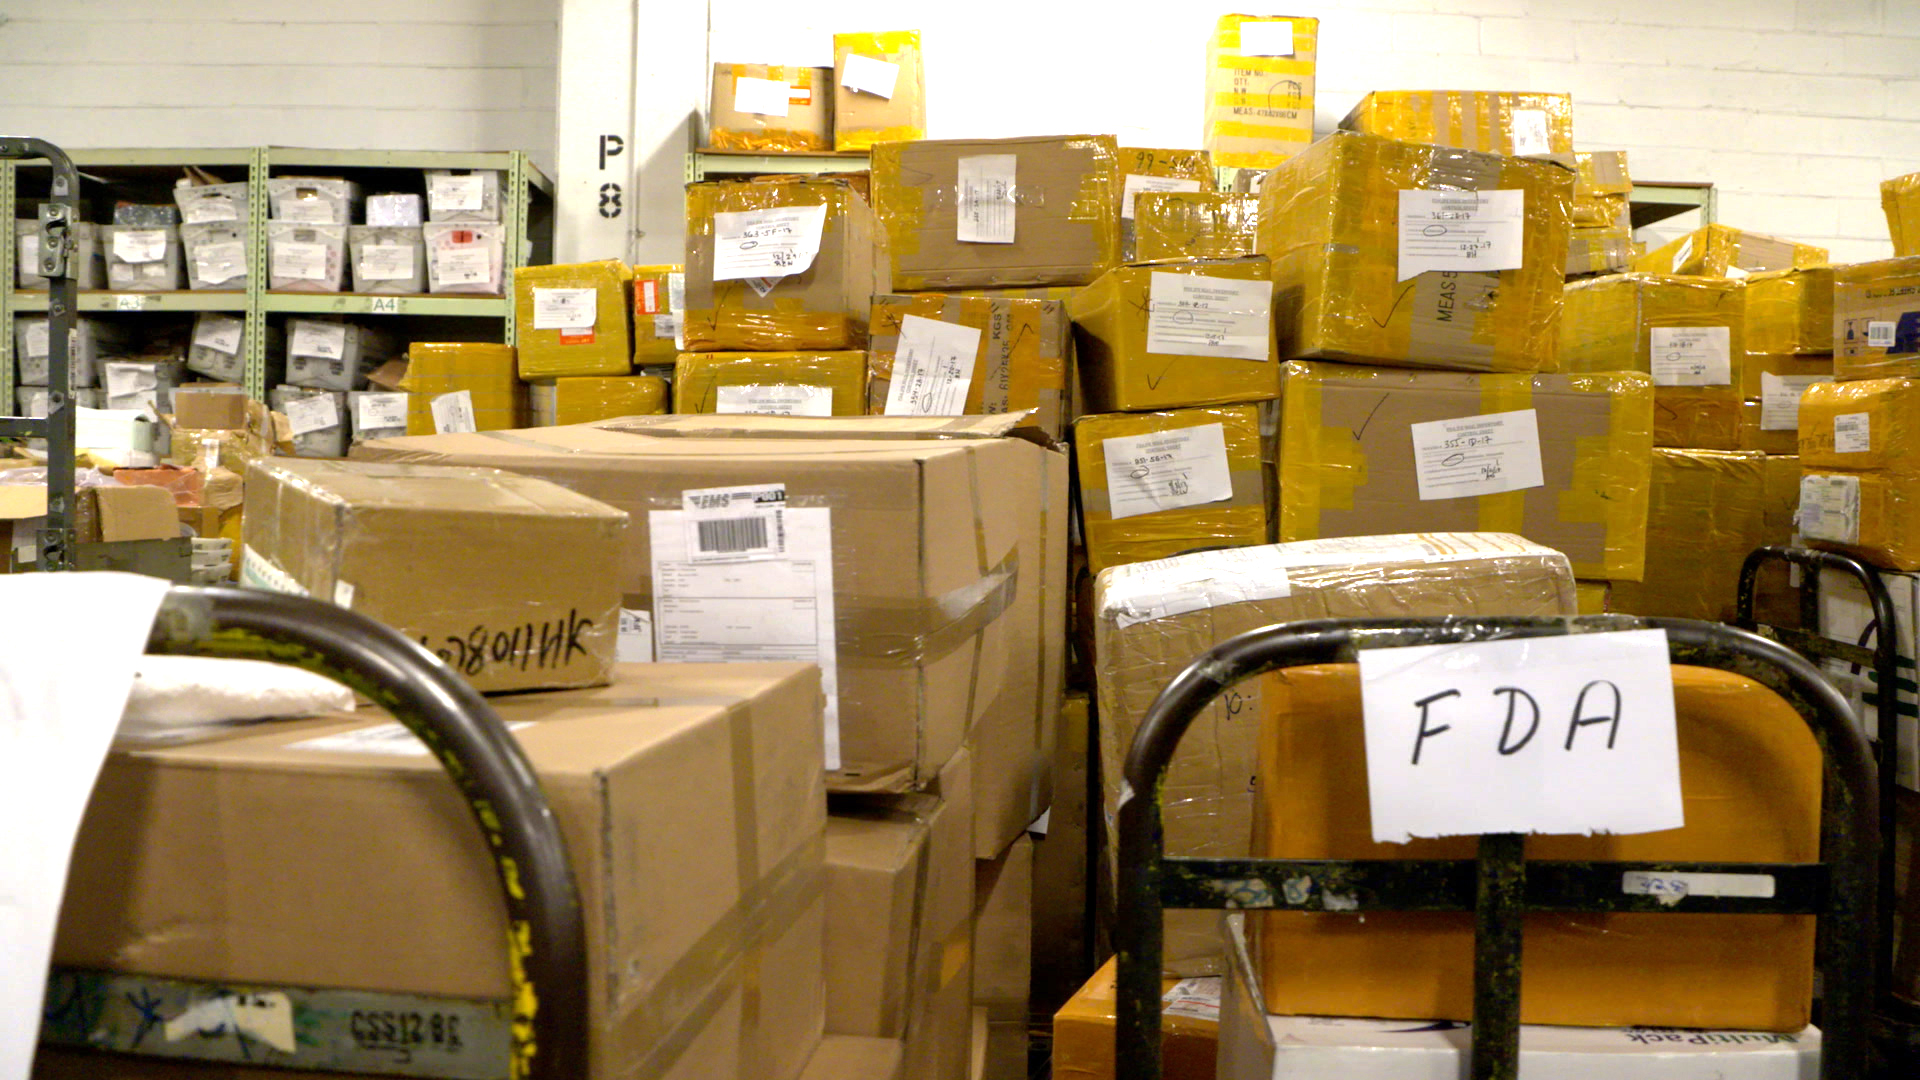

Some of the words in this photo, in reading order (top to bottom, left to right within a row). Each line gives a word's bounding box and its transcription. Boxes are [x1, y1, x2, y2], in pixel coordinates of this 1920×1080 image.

[374, 297, 396, 312] A4
[992, 313, 1002, 340] KGS
[700, 493, 731, 509] EMS
[1411, 679, 1622, 766] FDA
